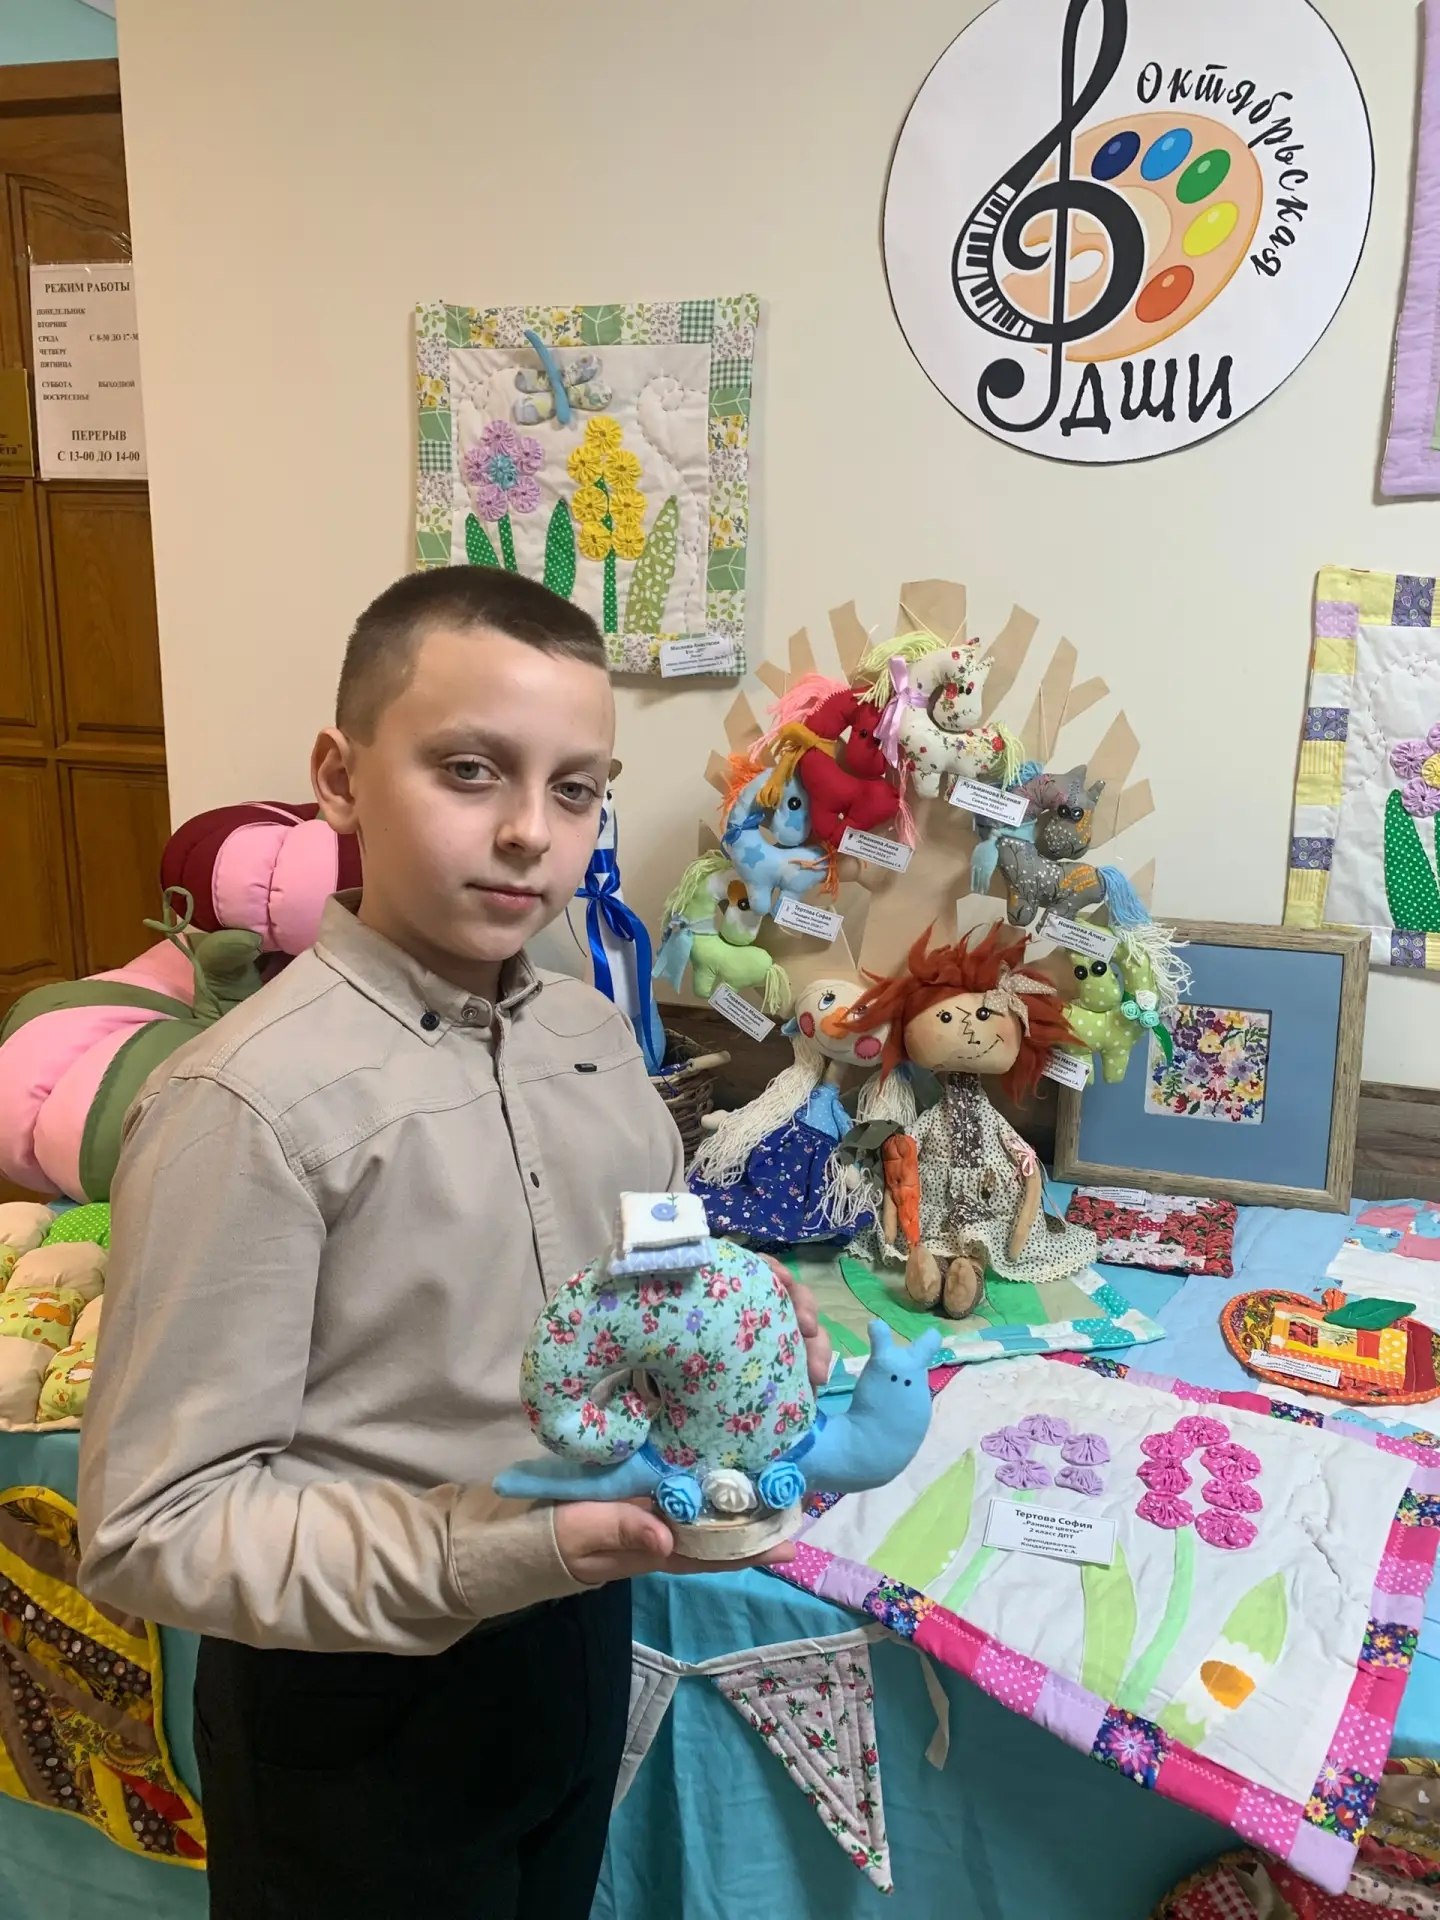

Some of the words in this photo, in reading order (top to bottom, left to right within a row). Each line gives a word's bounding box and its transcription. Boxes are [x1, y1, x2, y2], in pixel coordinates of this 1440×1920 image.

[1137, 61, 1310, 278] Октябрьская
[45, 283, 84, 293] РЕЖИМ
[87, 282, 130, 292] РАБОТЫ
[1060, 354, 1233, 437] ДШИ
[71, 430, 127, 441] ПЕРЕРЫВ
[57, 451, 66, 462] С
[69, 451, 94, 461] 13-00
[97, 451, 112, 462] ДО
[116, 451, 140, 462] 14-00
[1057, 920, 1087, 935] Новикова
[1087, 931, 1106, 941] Алиса
[1014, 1510, 1056, 1523] Тертова
[1057, 1517, 1092, 1529] София
[1020, 1541, 1062, 1552] Кондаурова
[1023, 1537, 1076, 1549] преподаватель
